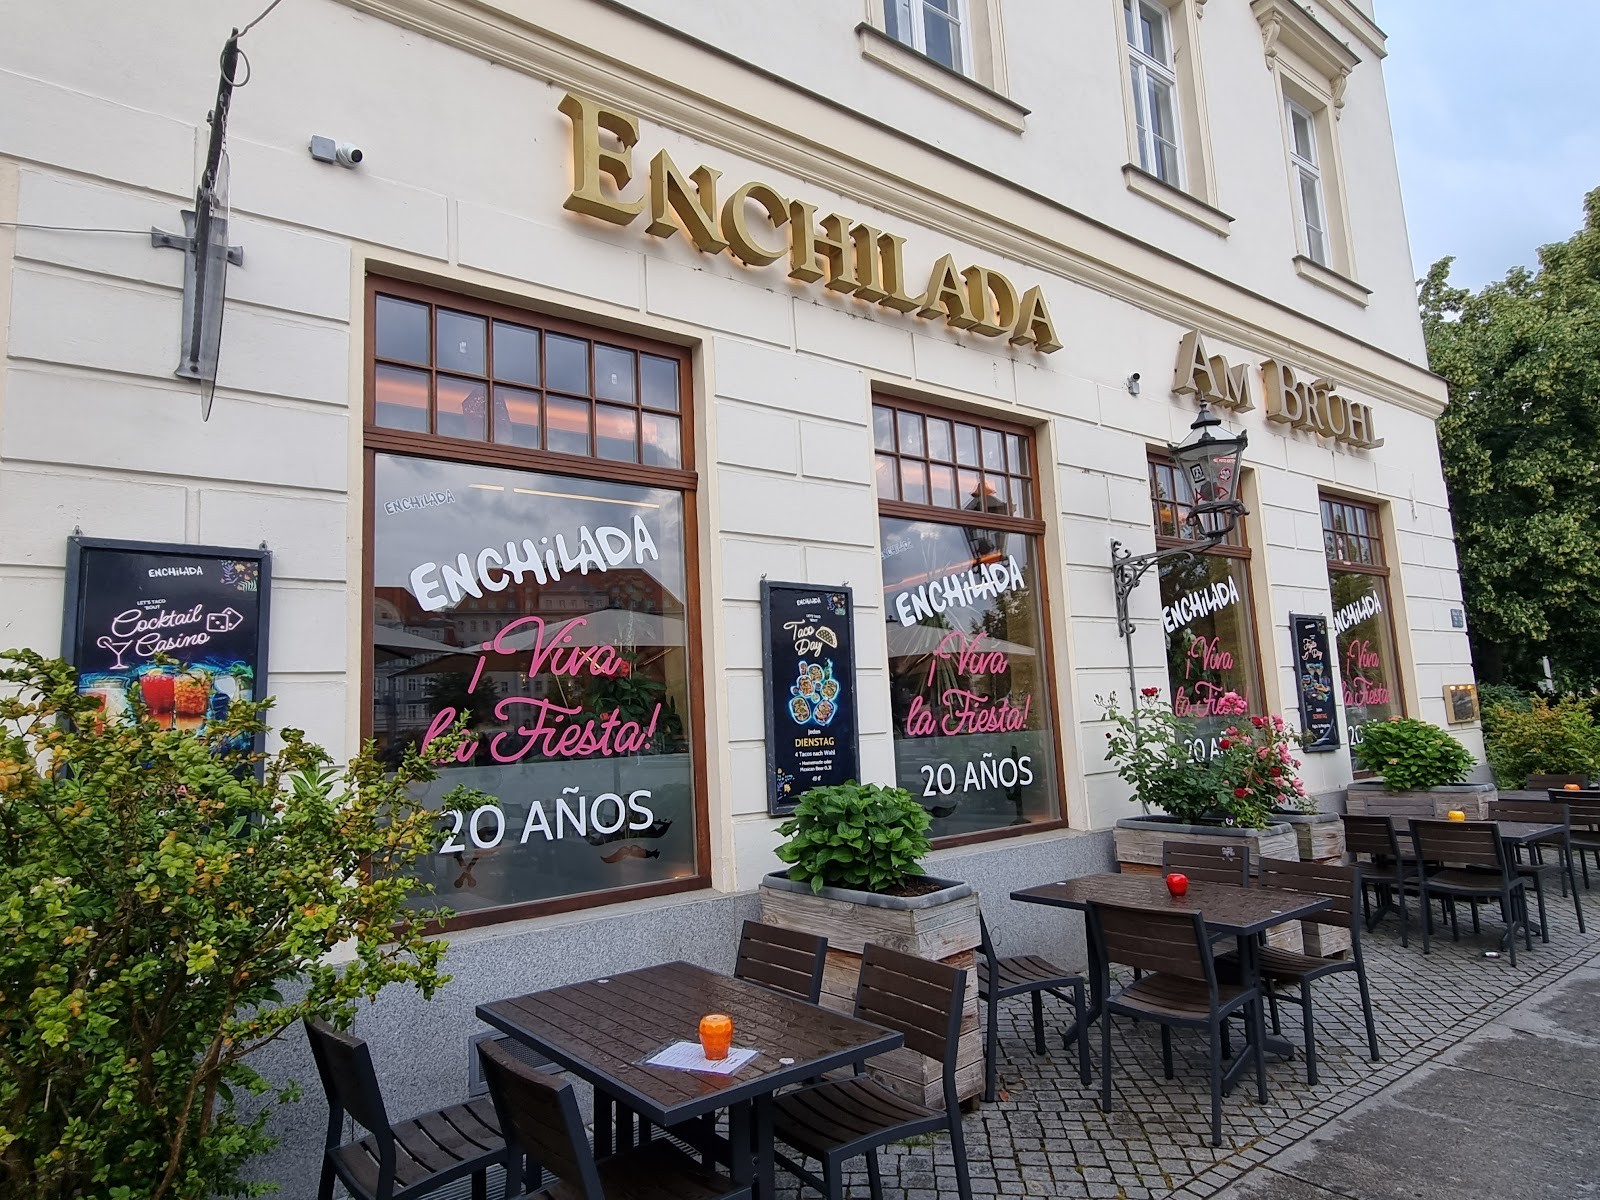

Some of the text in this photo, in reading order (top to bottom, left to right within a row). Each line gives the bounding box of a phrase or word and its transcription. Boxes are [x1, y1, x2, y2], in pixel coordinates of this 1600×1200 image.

[557, 91, 1065, 355] ENCHILADA
[112, 604, 203, 637] Cocktail
[783, 619, 815, 641] Taco
[135, 633, 210, 657] Casino
[795, 638, 823, 657] Day
[491, 696, 662, 763] Fiesta!
[906, 688, 1031, 737] la Fiesta!
[795, 737, 834, 747] DIENSTAG
[920, 751, 1034, 797] 20 AÑOS
[439, 786, 654, 854] 20 AÑOS
